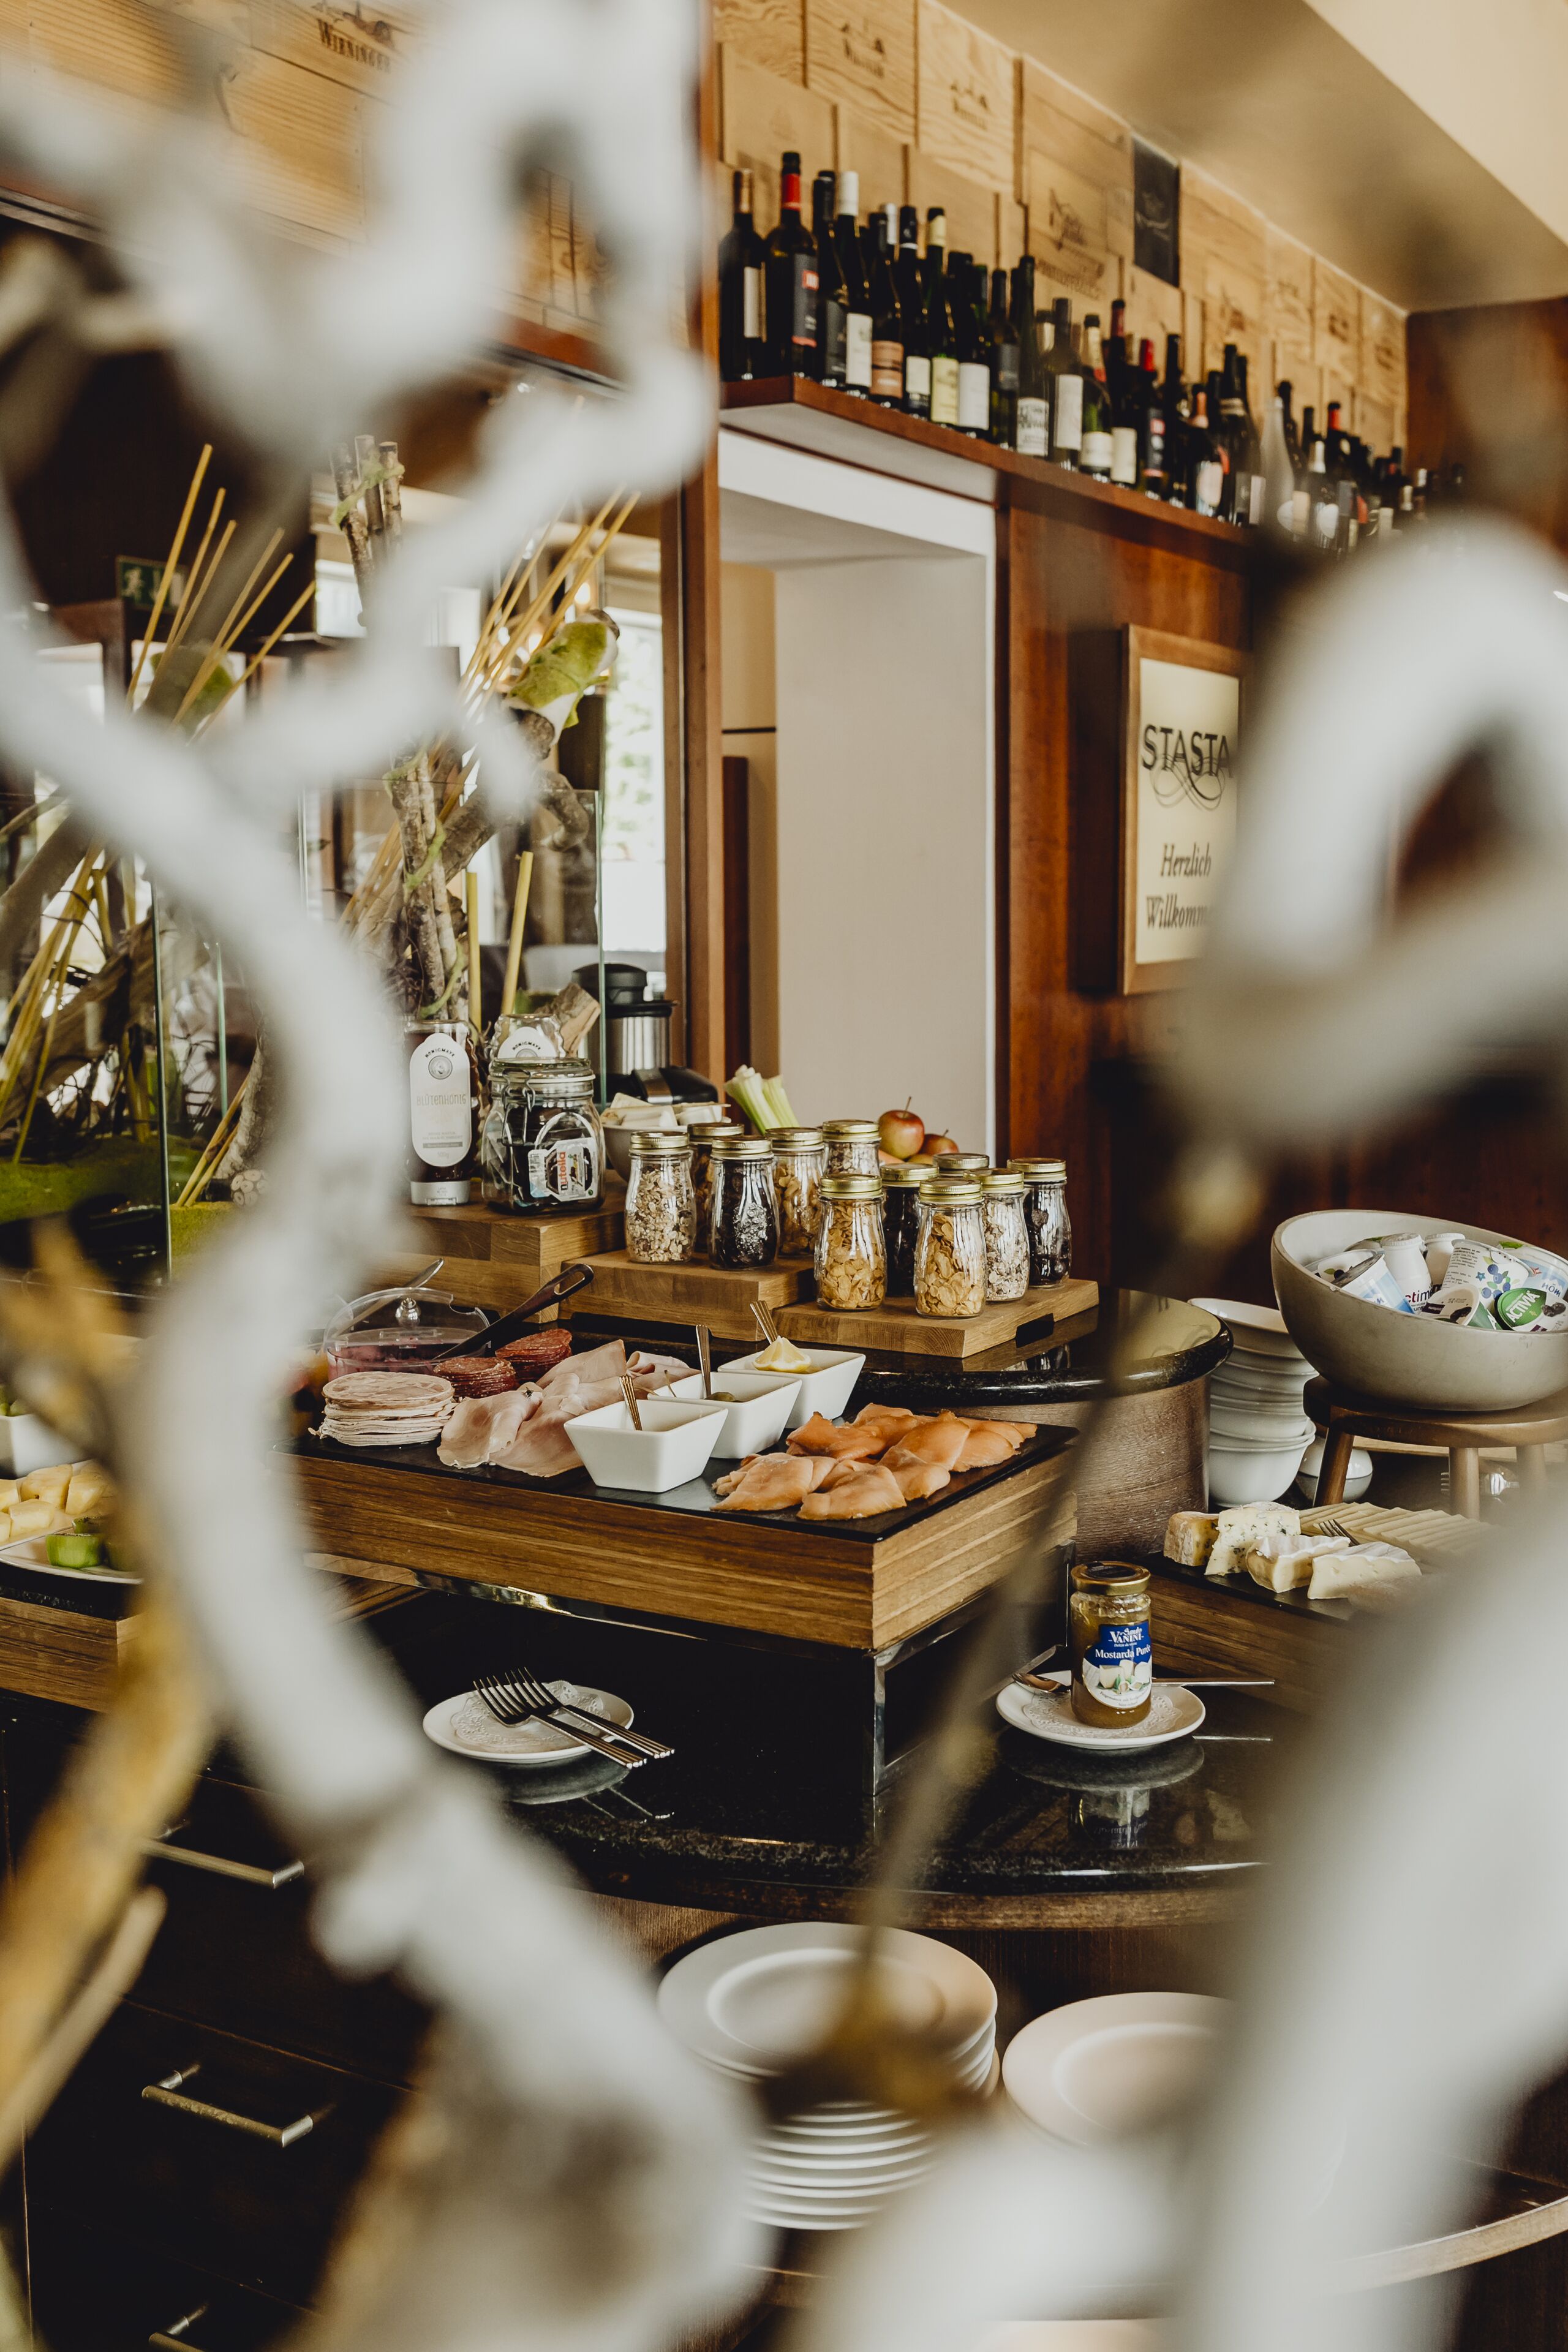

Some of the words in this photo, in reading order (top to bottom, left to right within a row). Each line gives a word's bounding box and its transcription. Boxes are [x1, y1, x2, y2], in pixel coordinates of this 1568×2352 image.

[1142, 724, 1234, 778] STASTA
[1160, 842, 1212, 877] Herzlich
[557, 1151, 569, 1191] nutella
[1506, 1291, 1540, 1323] ACTIVIA
[1095, 1649, 1134, 1659] Mostarda
